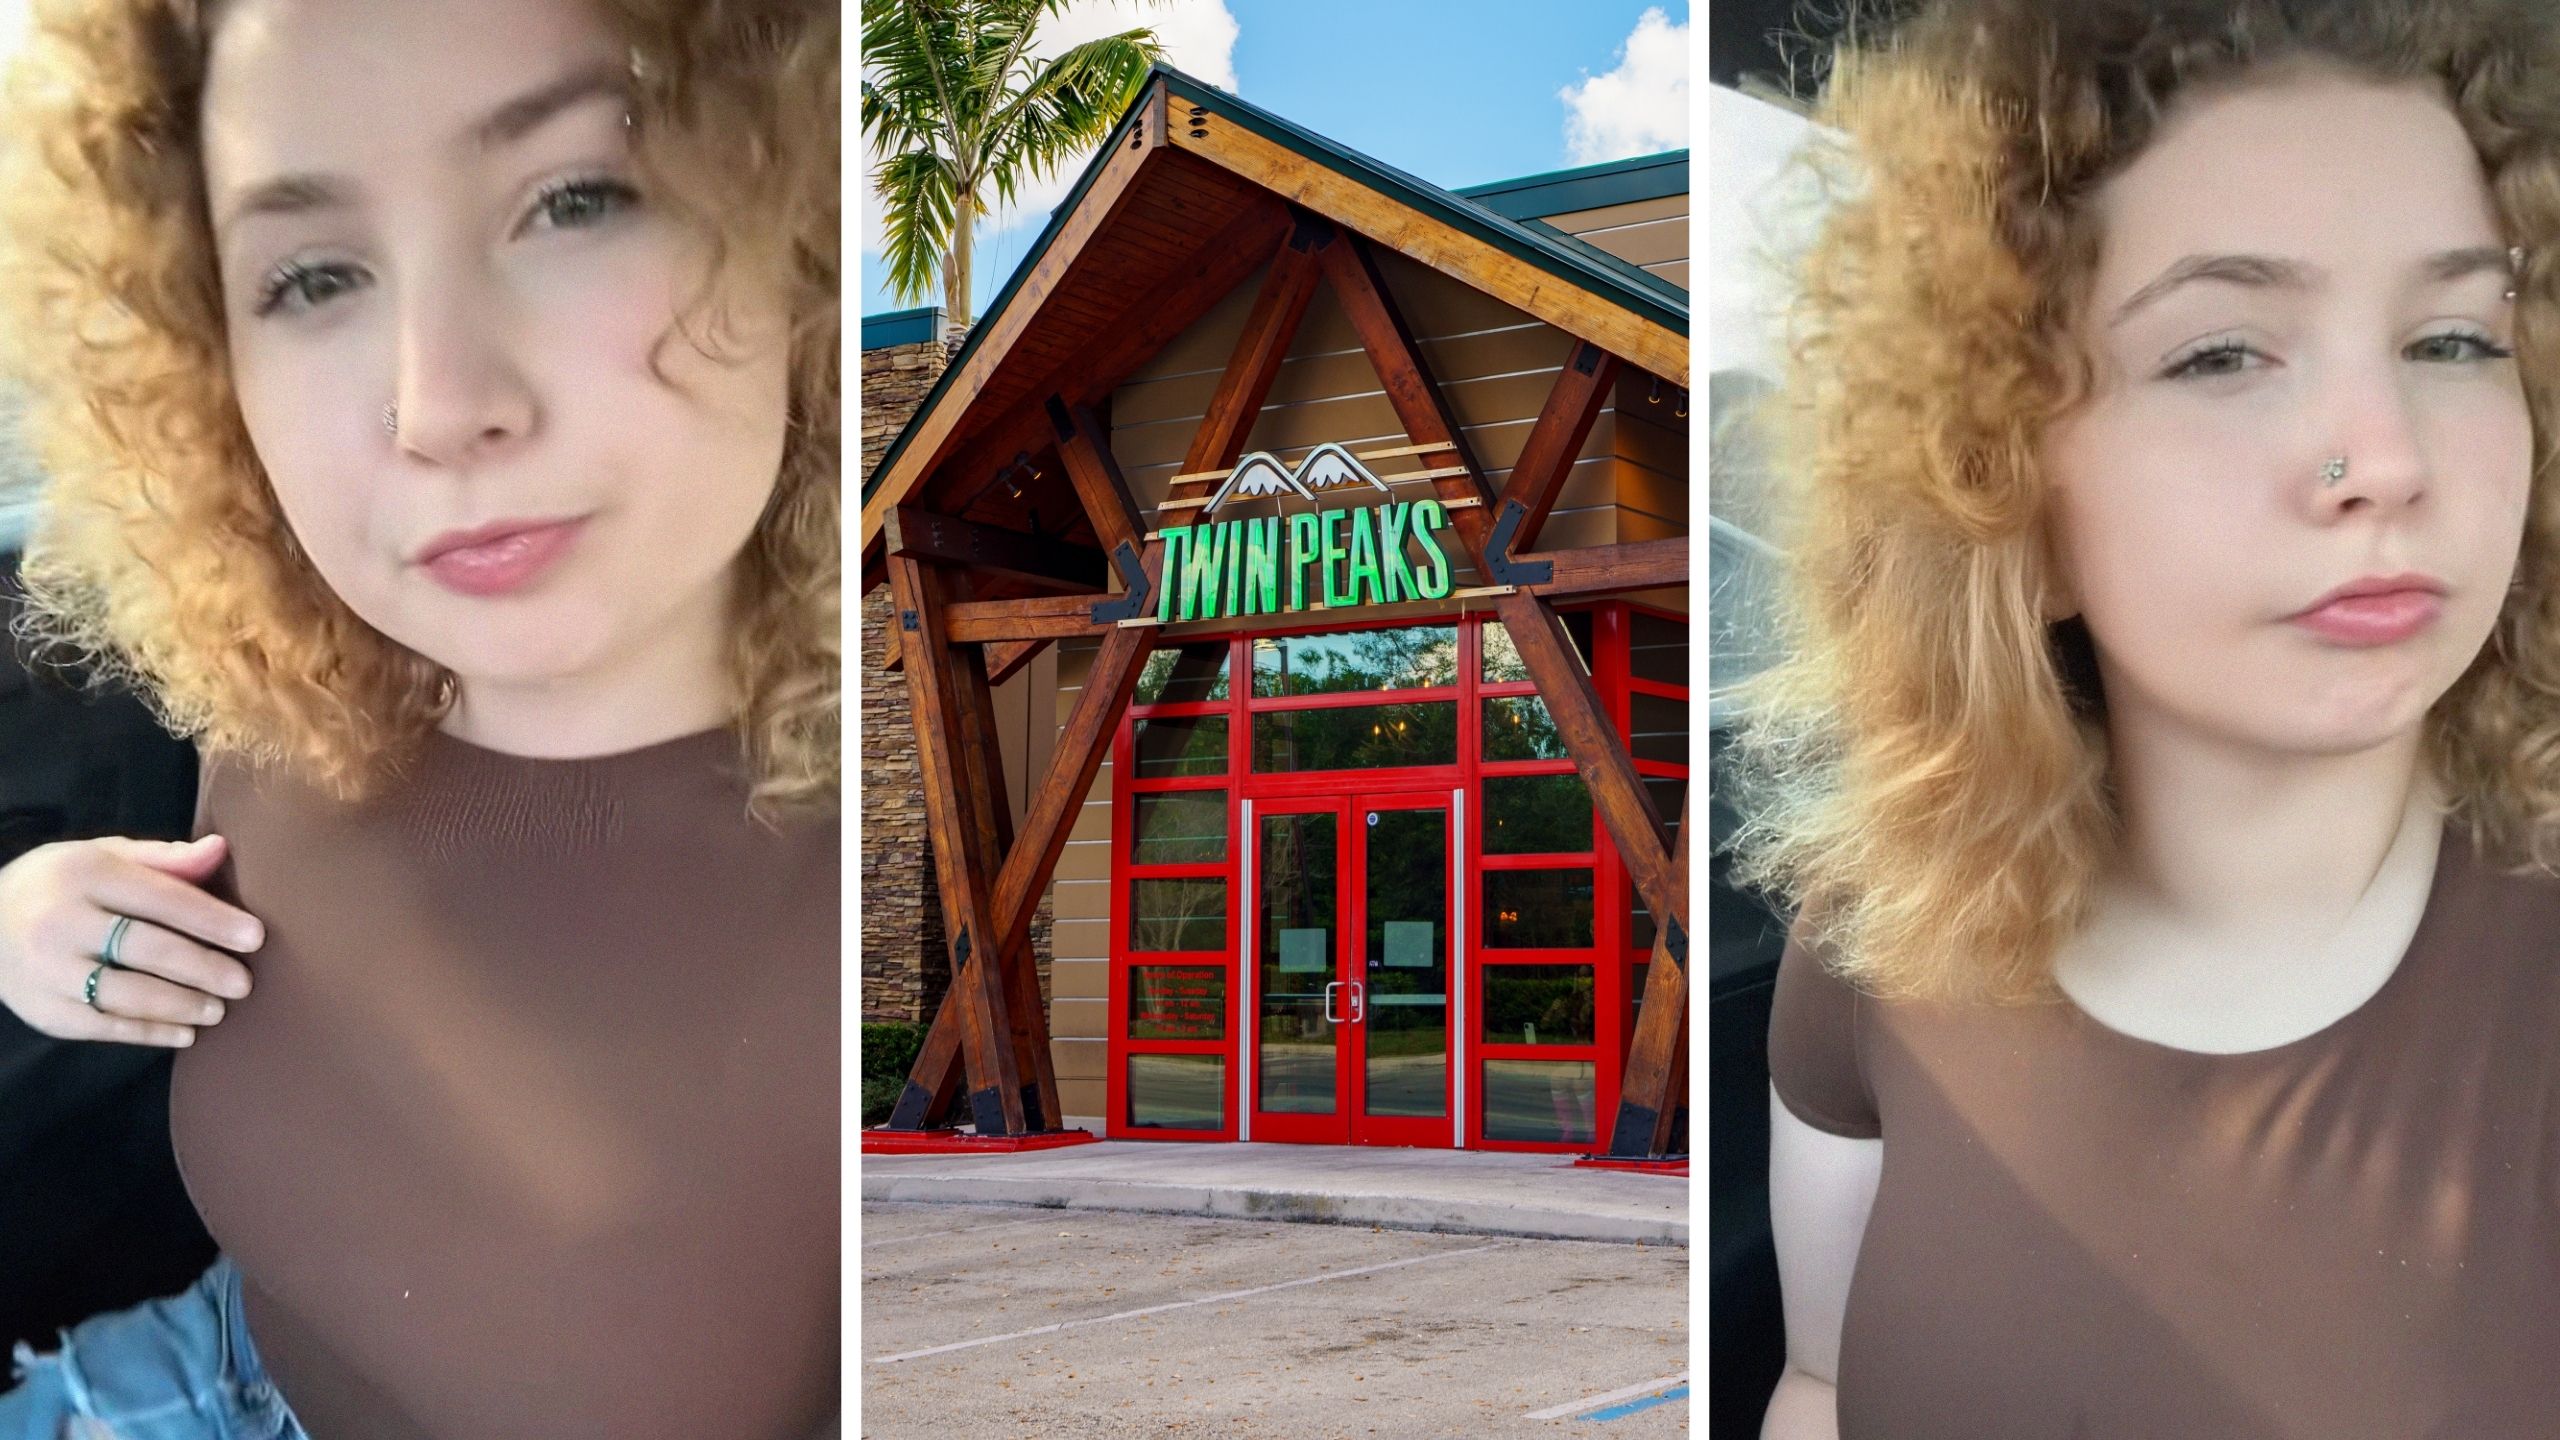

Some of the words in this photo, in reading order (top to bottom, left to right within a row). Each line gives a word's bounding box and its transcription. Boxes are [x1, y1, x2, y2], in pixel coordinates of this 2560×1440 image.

[1157, 515, 1282, 623] TWIN
[1290, 499, 1454, 611] PEAKS
[1177, 970, 1214, 980] Operation
